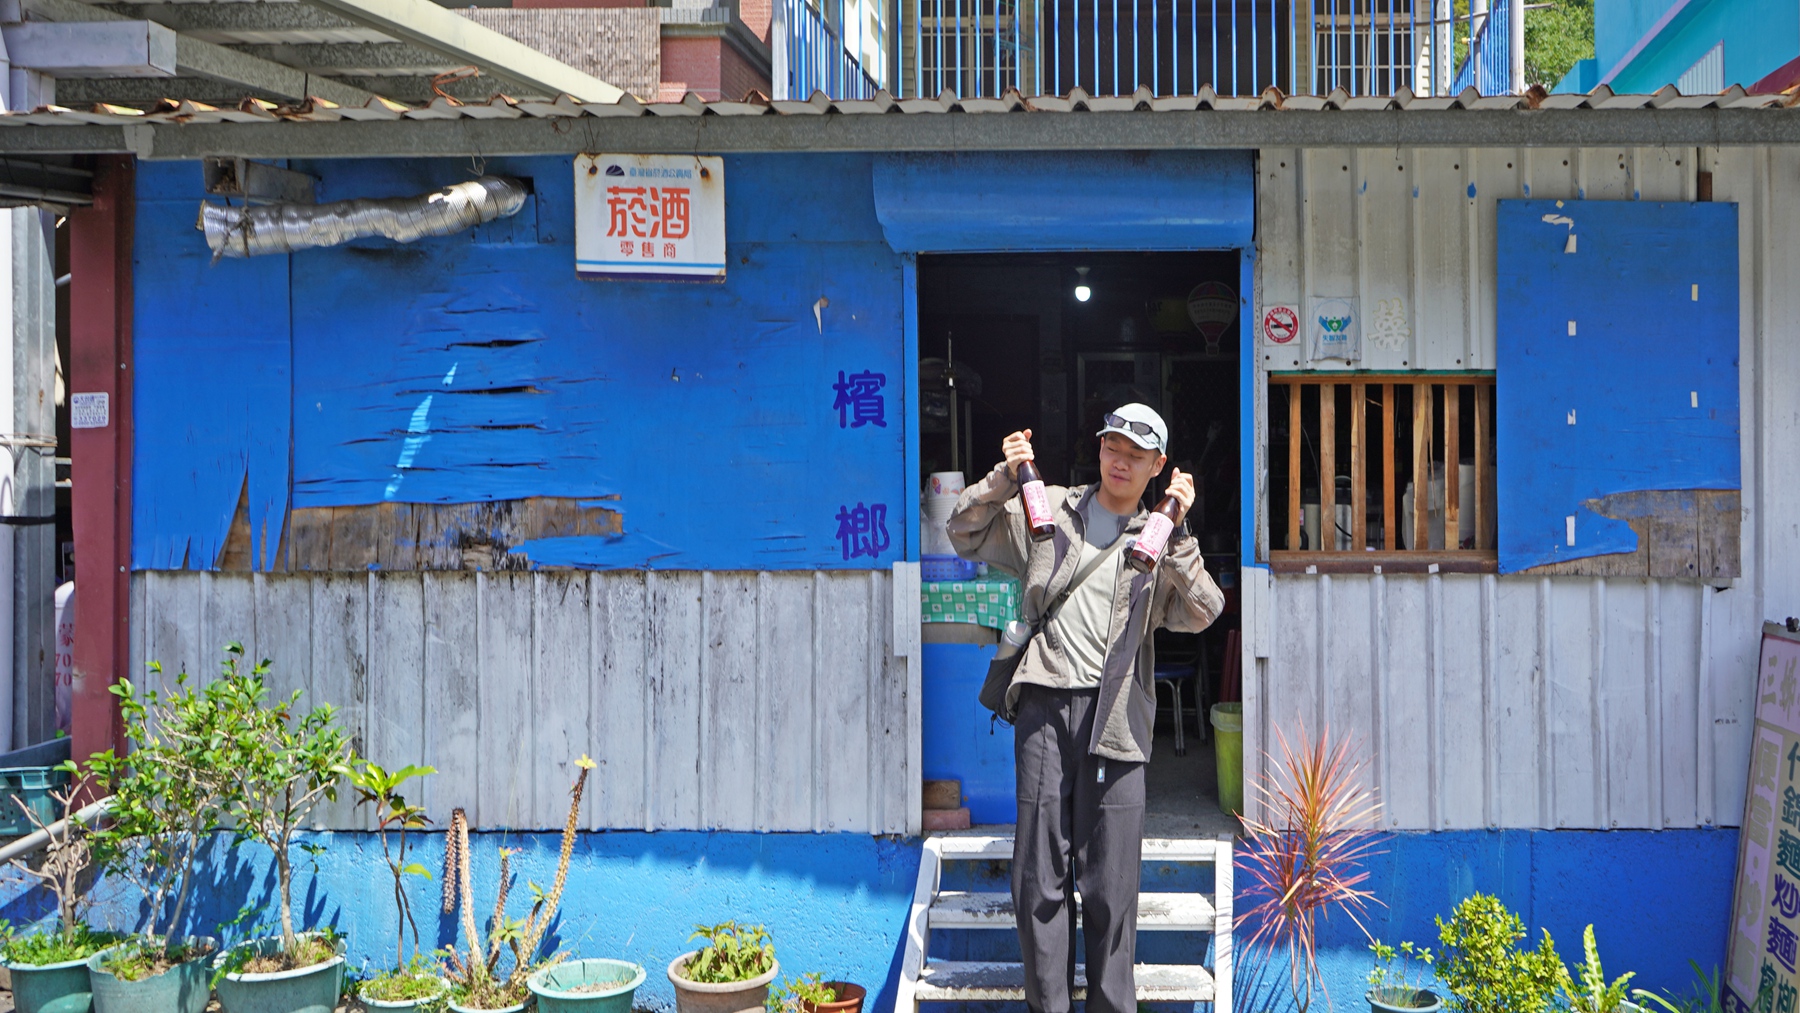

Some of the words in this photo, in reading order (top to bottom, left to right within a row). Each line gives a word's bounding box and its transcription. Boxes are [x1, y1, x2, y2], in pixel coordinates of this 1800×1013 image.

[606, 186, 690, 239] 菸酒
[620, 241, 676, 258] 零售商
[832, 369, 890, 561] 檳榔
